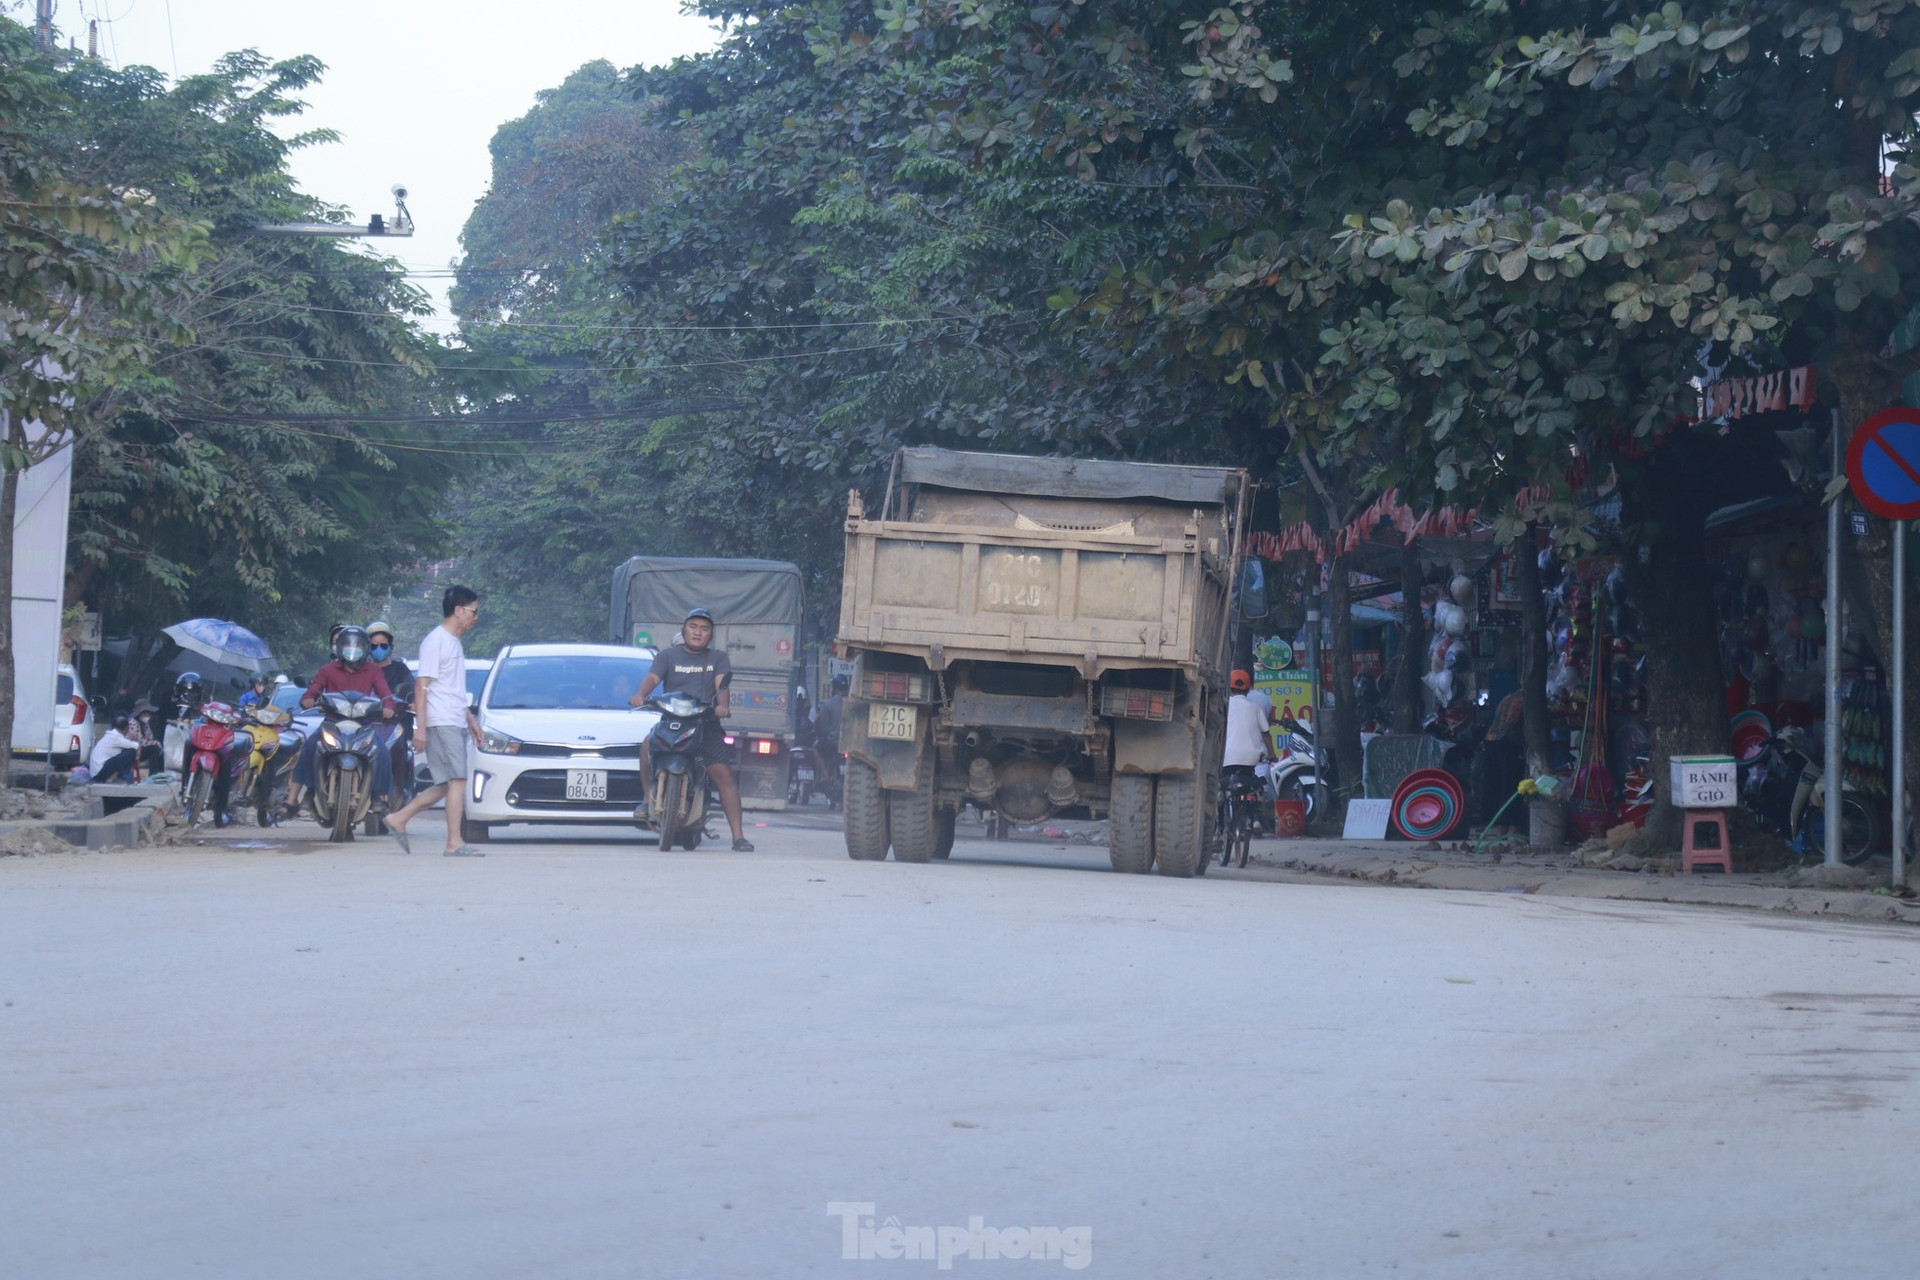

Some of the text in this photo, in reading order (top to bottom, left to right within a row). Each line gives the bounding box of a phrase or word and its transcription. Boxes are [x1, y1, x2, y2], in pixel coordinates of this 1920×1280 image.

[881, 706, 906, 722] 21C
[576, 773, 598, 785] 21A
[1689, 770, 1728, 784] BÁNH
[567, 785, 606, 799] 084.65
[1697, 787, 1724, 801] GIÒ
